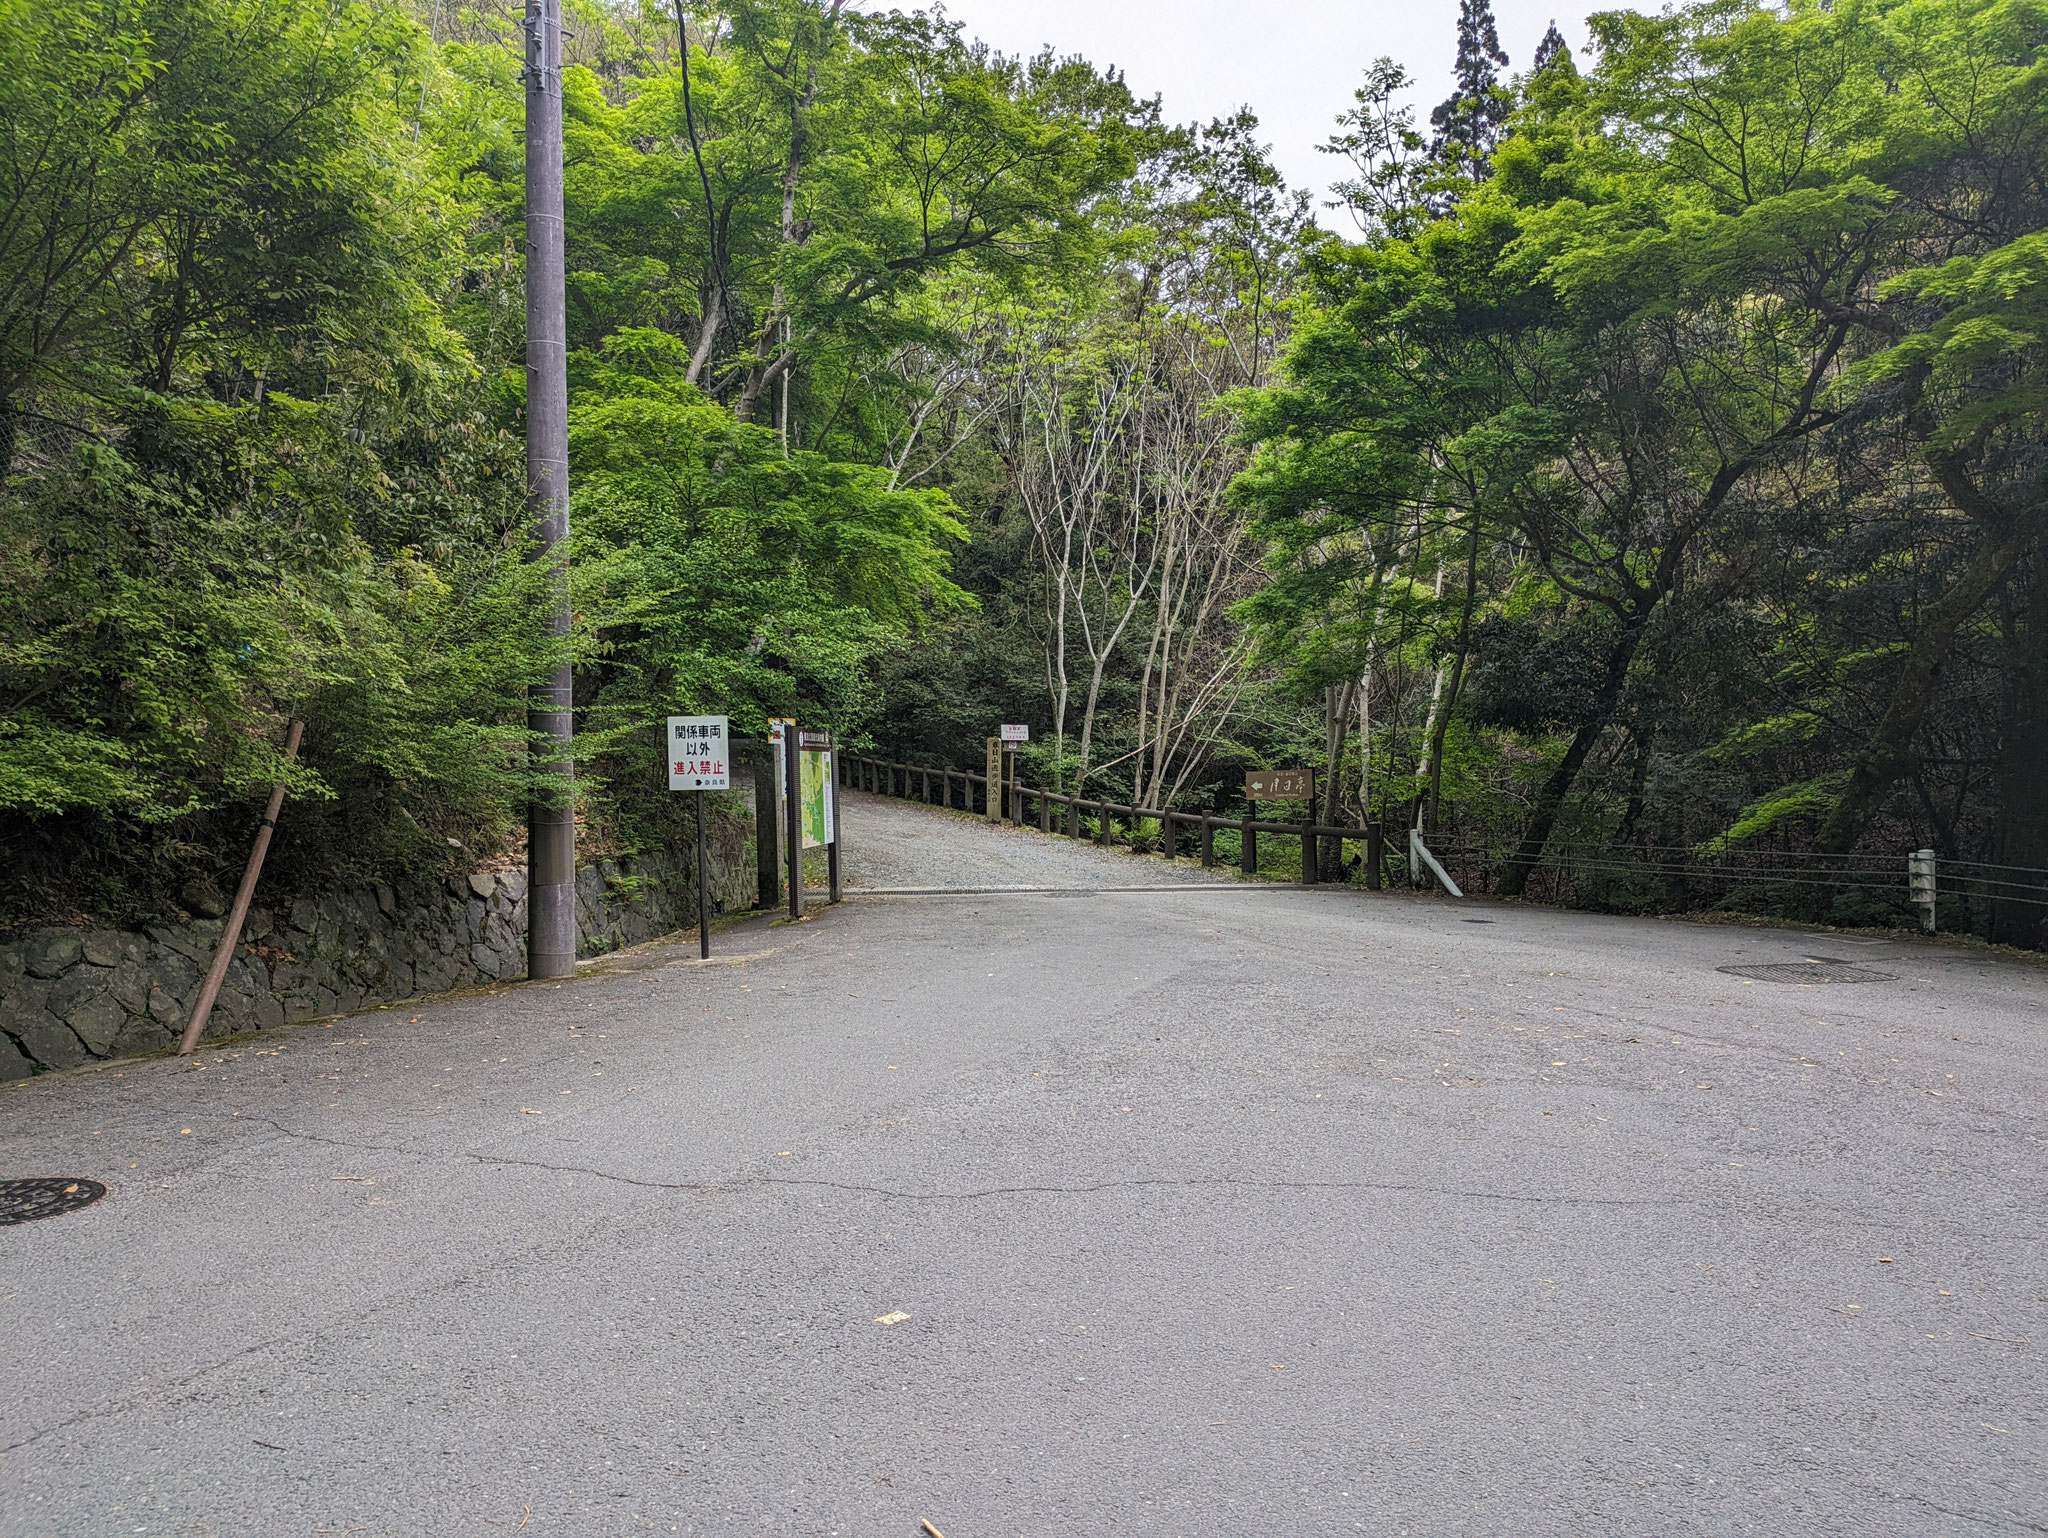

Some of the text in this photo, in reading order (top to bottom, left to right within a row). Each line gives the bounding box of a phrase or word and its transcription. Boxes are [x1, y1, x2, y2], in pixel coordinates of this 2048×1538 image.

[675, 725, 721, 739] 関係車両
[686, 742, 711, 756] 以外
[674, 760, 724, 775] 進入禁止
[1270, 776, 1305, 793] 月日亭
